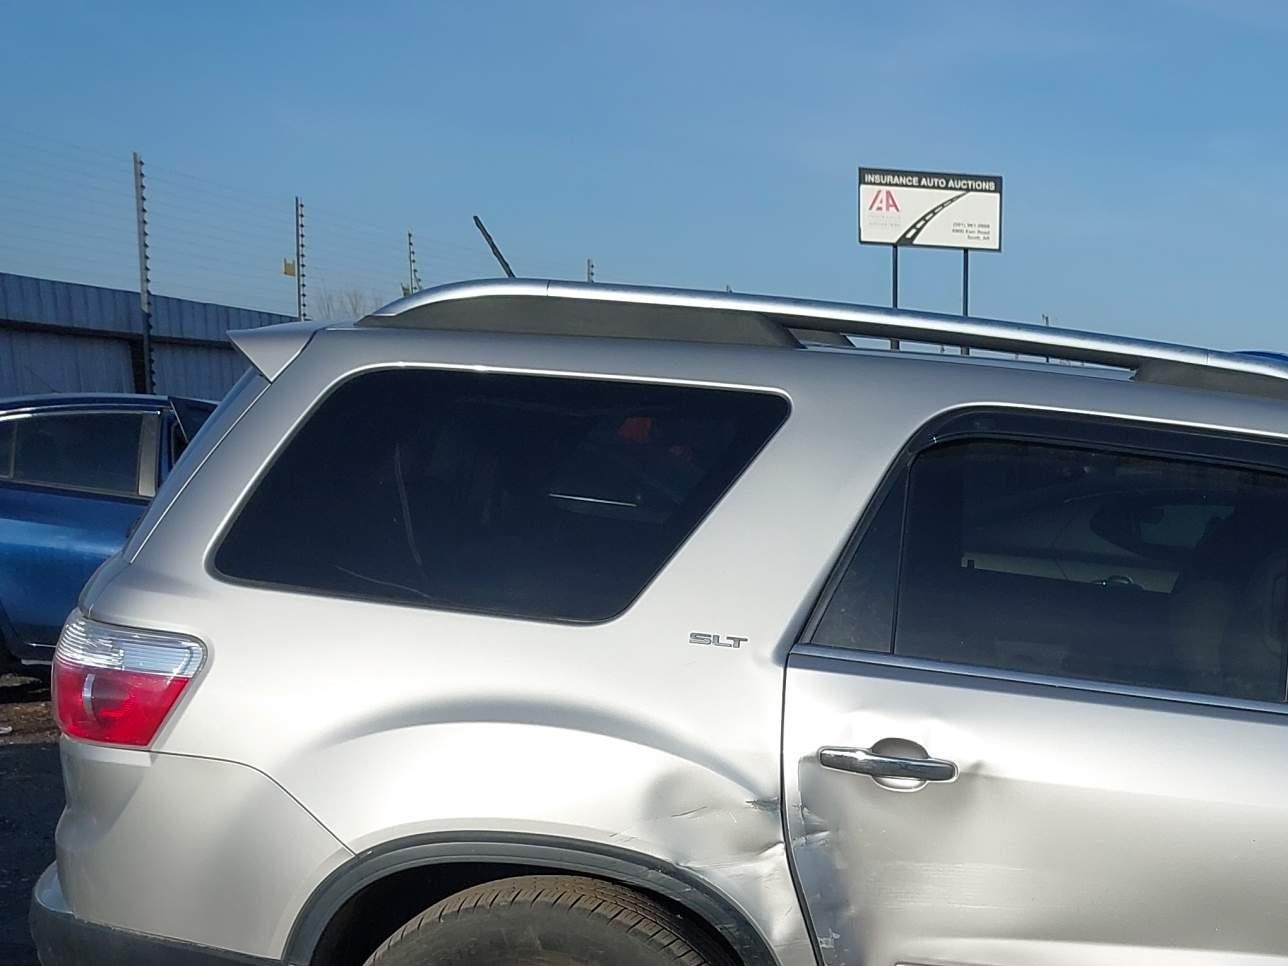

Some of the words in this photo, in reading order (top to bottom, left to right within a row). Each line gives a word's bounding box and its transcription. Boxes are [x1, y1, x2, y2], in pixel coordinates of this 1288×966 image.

[864, 173, 919, 186] INSURANCE
[920, 177, 946, 188] AUTO
[948, 178, 996, 191] AUCTIONS
[689, 632, 748, 649] SLT
